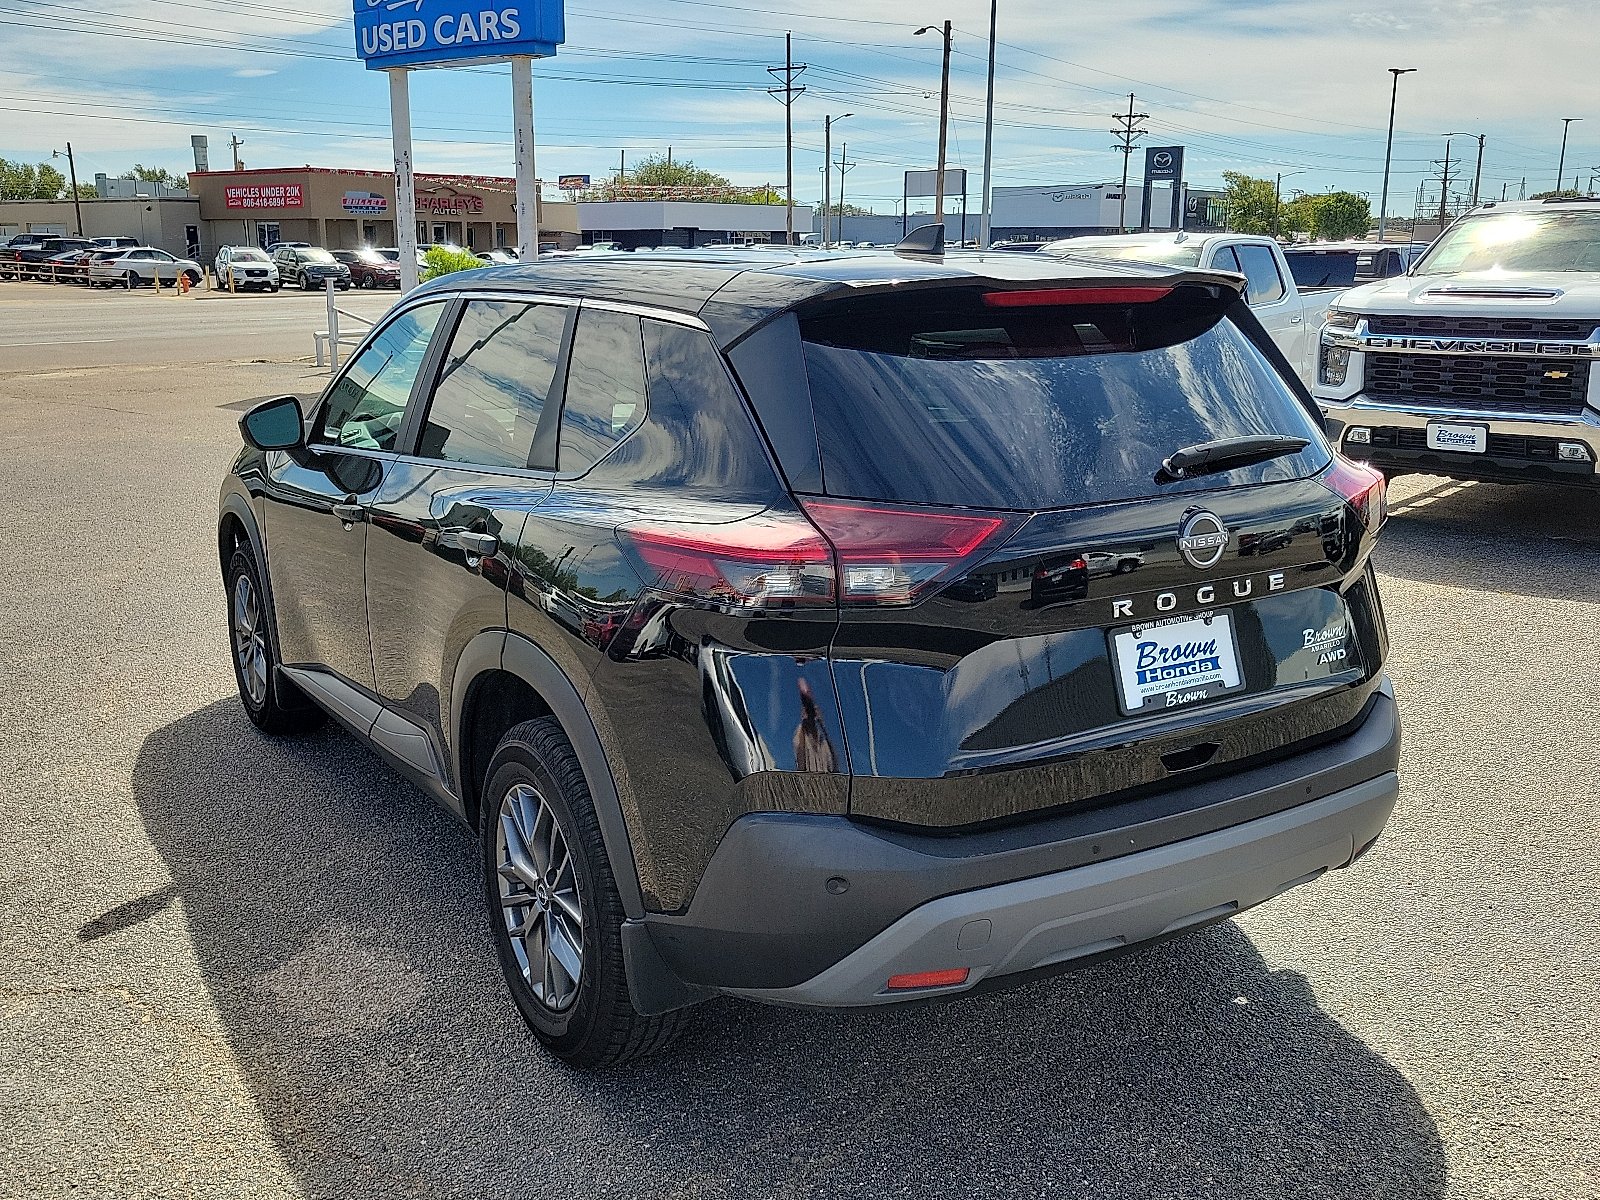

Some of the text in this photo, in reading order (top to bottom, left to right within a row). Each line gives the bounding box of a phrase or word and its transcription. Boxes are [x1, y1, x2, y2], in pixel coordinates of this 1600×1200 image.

[362, 9, 521, 54] USED CARS
[226, 186, 300, 198] VEHICLES UNDER 20K
[242, 197, 285, 207] 806-418-6894
[1365, 337, 1593, 355] CHEVROLET
[1436, 429, 1477, 440] Brown
[1182, 533, 1228, 549] NISSAN
[1112, 574, 1285, 618] ROGUE
[1131, 611, 1214, 632] BROWN AUTOMOTIVE GROUP
[1302, 626, 1344, 646] Brown
[1136, 638, 1218, 670] Brown
[1311, 640, 1341, 653] AMARILLO
[1318, 649, 1346, 665] AWD
[1145, 661, 1213, 683] Honda
[1165, 689, 1208, 707] Brown
